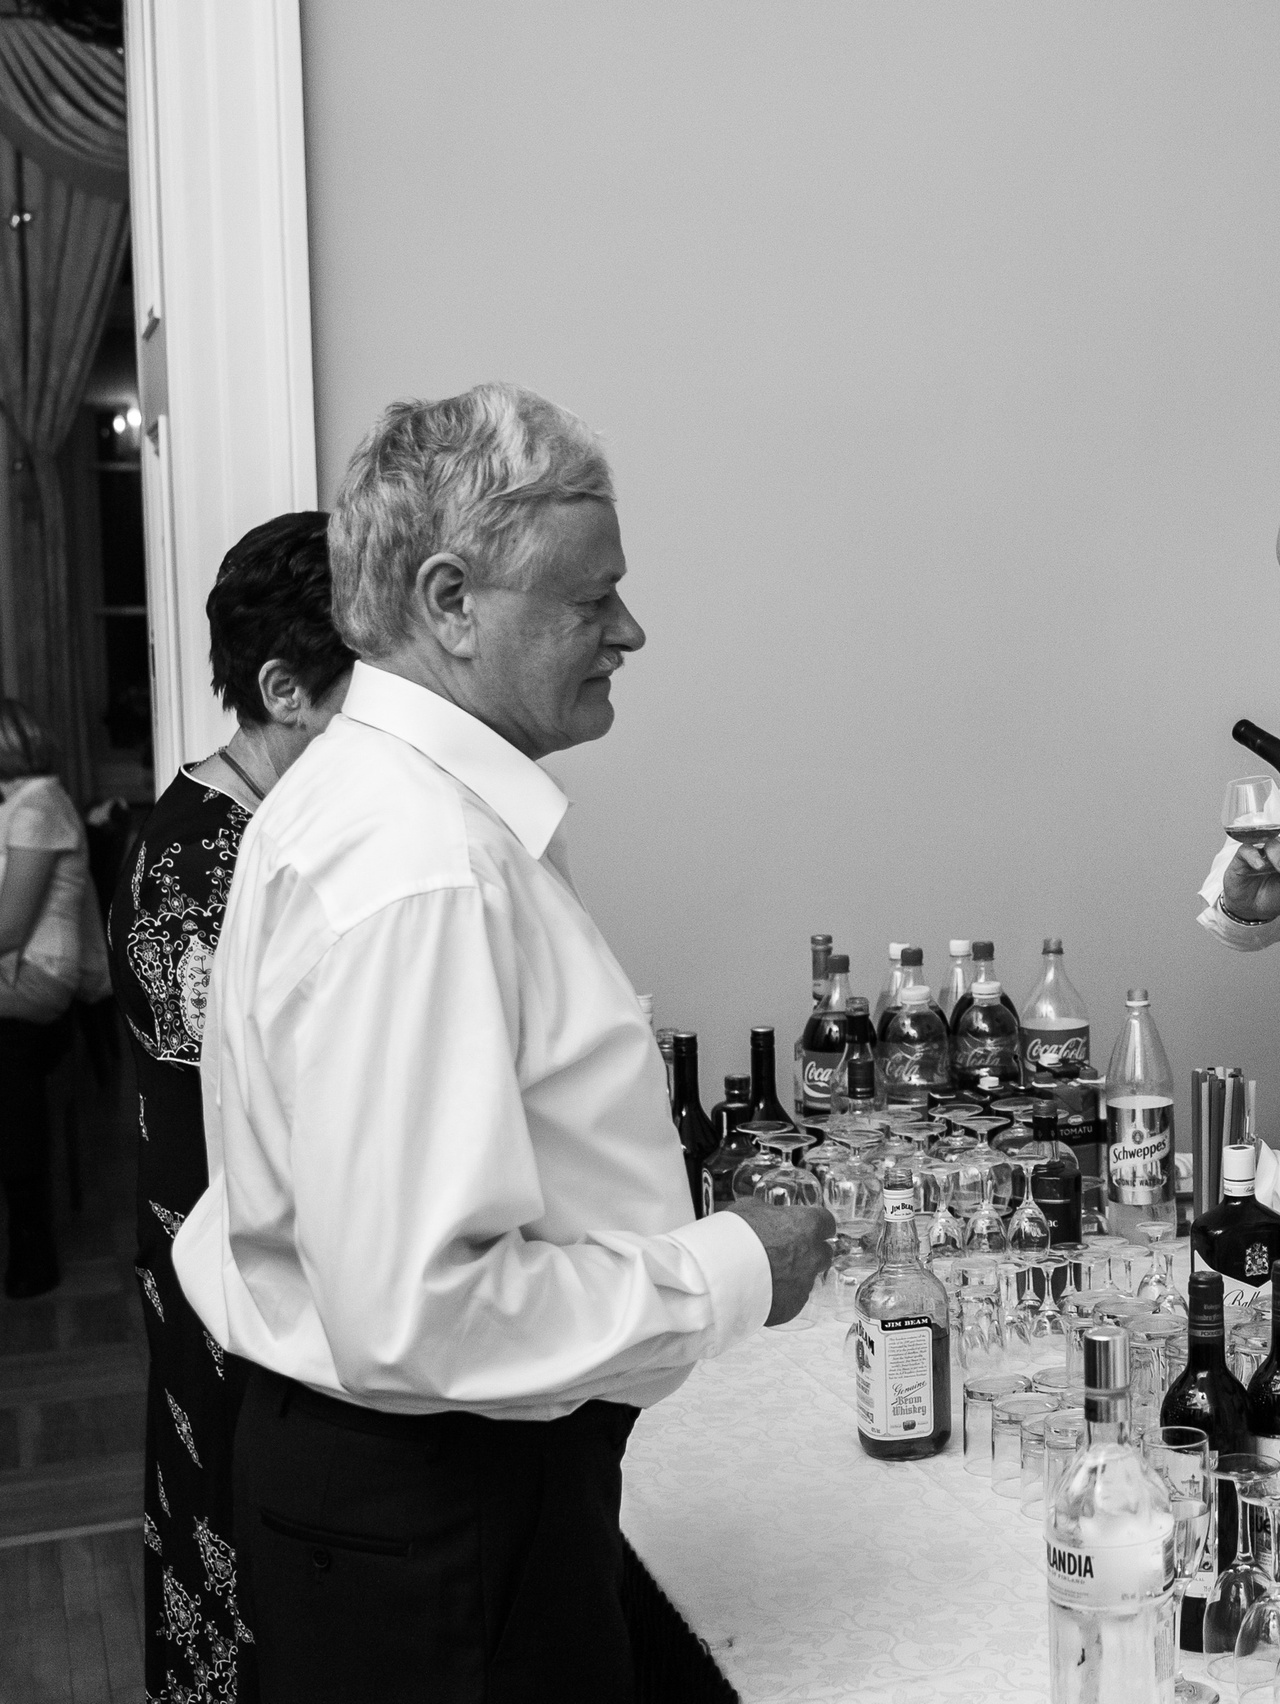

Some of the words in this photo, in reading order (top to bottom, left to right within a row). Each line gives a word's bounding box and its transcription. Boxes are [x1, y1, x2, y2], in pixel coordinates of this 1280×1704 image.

[1112, 1139, 1167, 1164] Schweppes
[904, 1318, 929, 1326] BEAM
[892, 1405, 927, 1416] Whiskey
